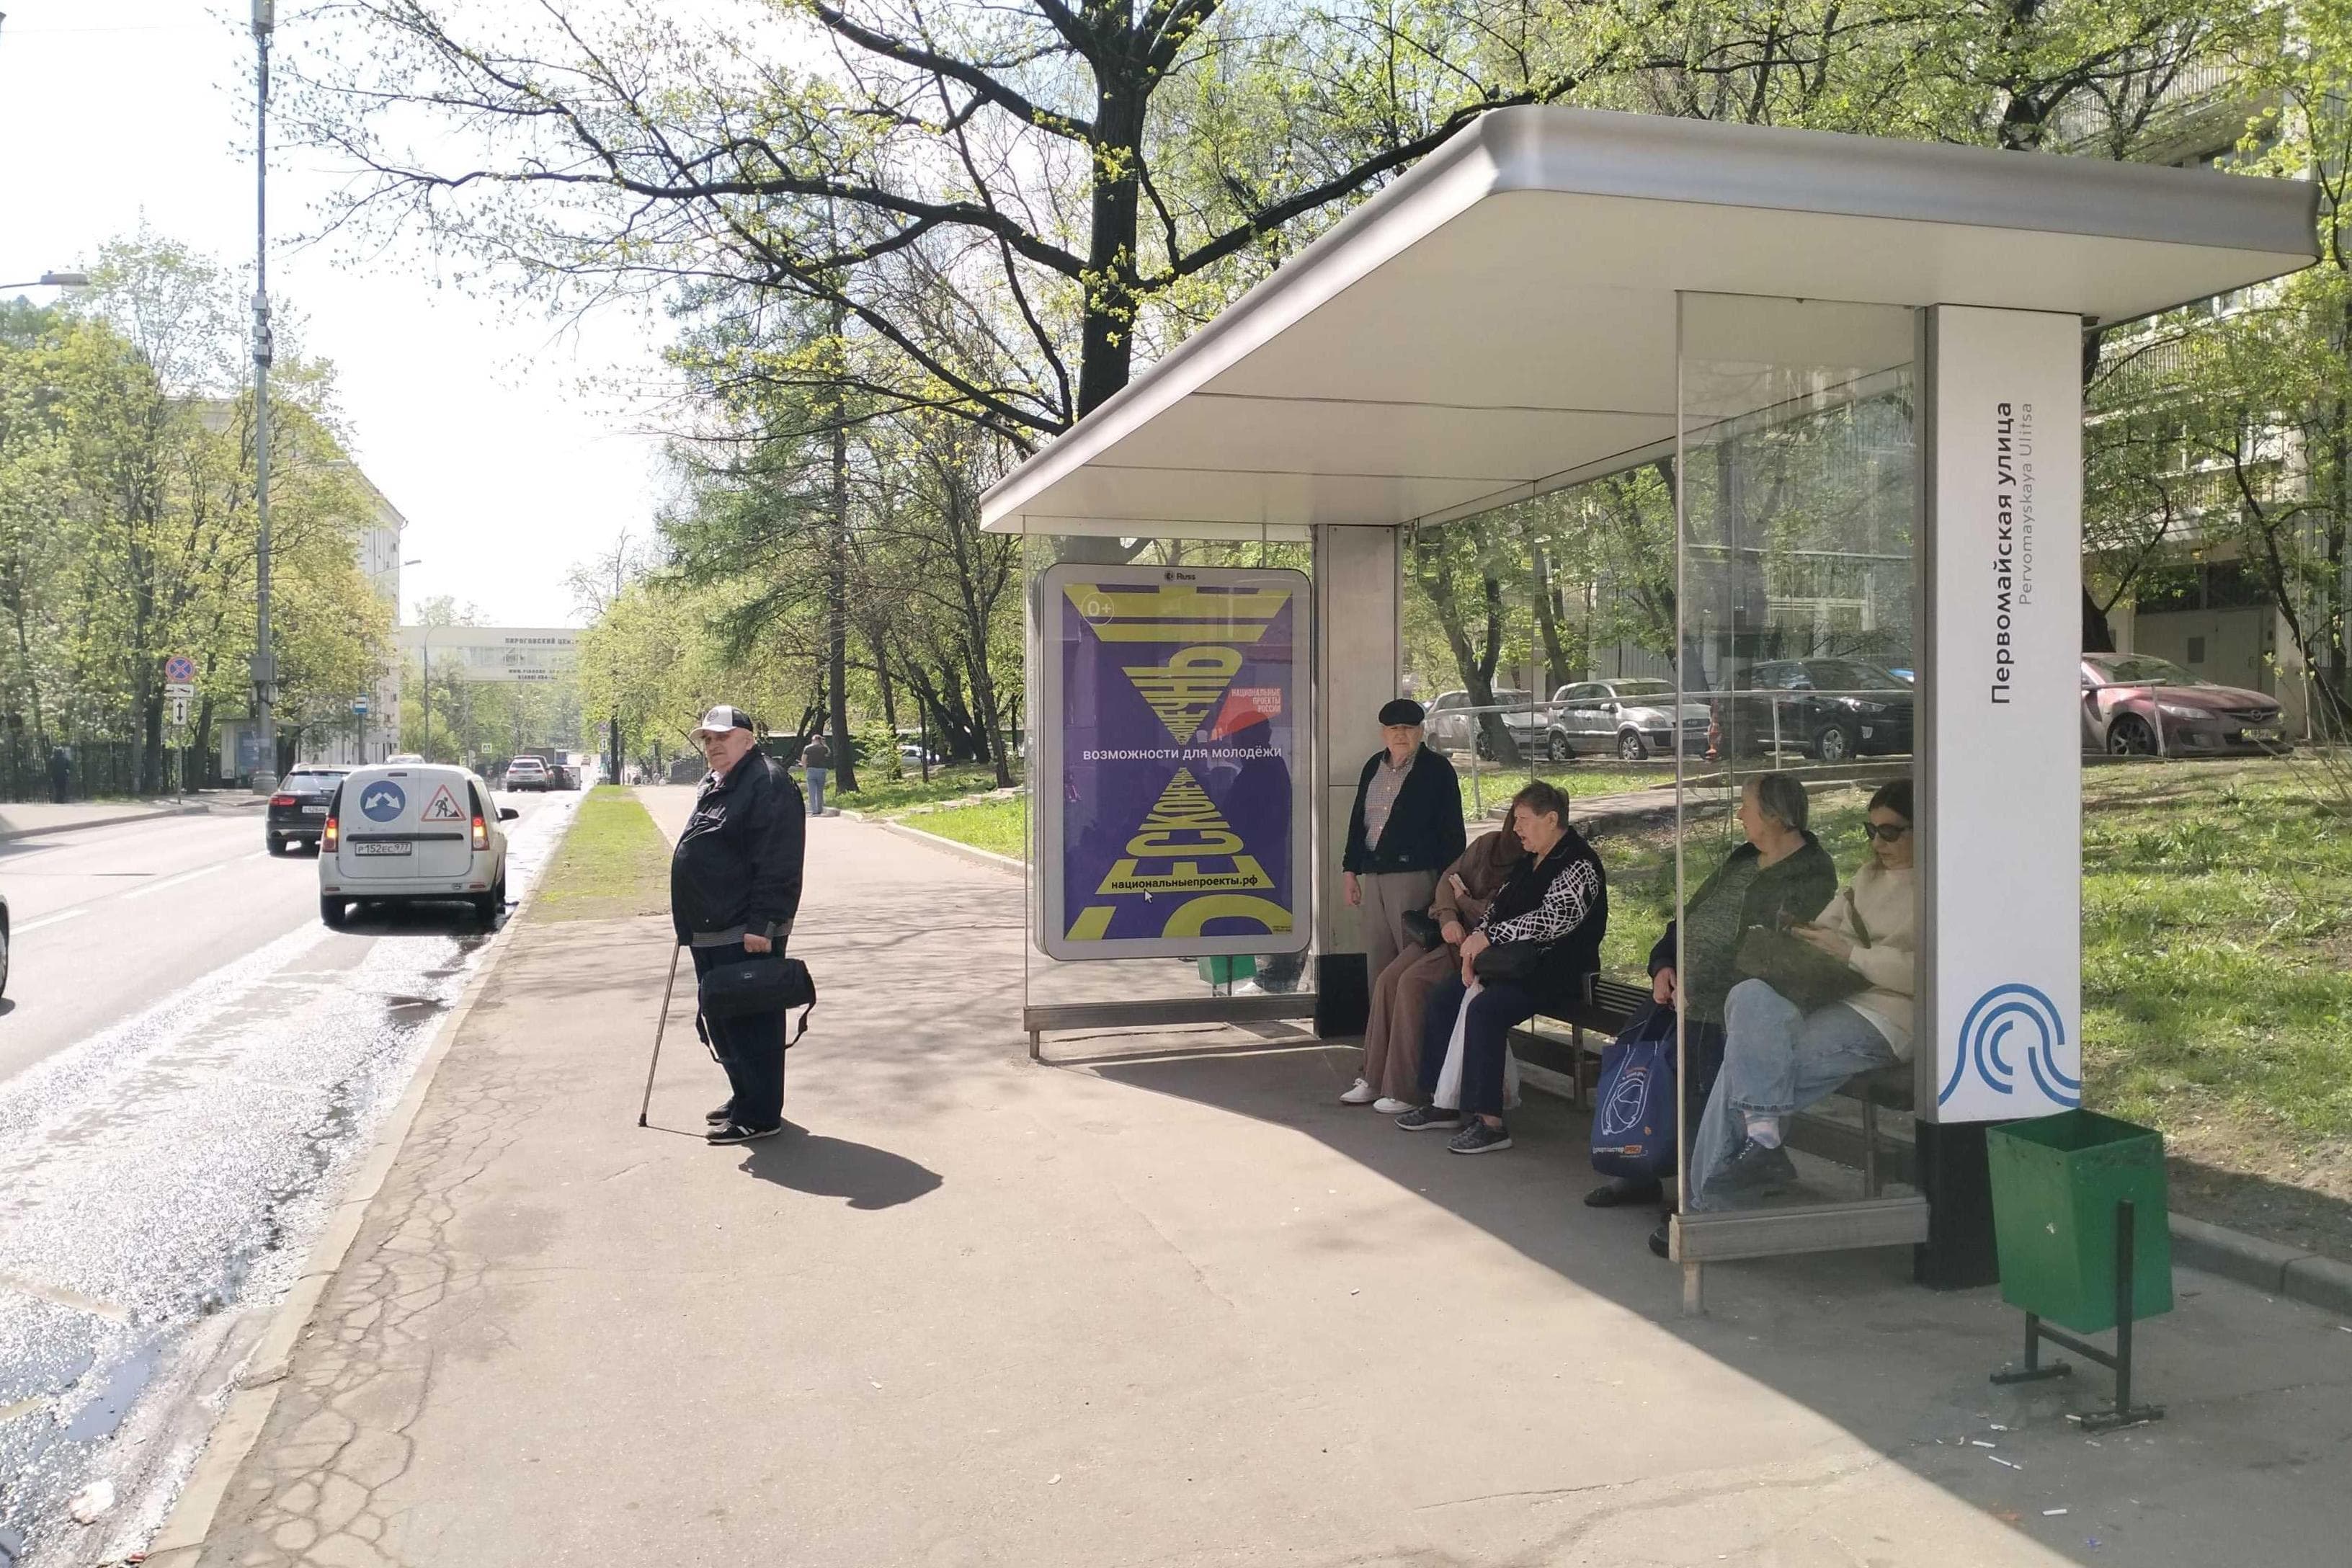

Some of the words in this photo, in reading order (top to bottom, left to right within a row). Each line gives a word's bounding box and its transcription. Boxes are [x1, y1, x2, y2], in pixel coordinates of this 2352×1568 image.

[1997, 402, 2016, 485] улица
[2019, 403, 2033, 456] Ulitsa
[2020, 462, 2036, 605] Pervomayskaya
[1087, 600, 1112, 617] 0+
[1992, 494, 2014, 704] Первомайская
[1083, 749, 1180, 760] возможности
[1182, 748, 1208, 761] для
[1212, 745, 1282, 760] молодёжи
[1111, 874, 1258, 889] национальныепроекты.рф
